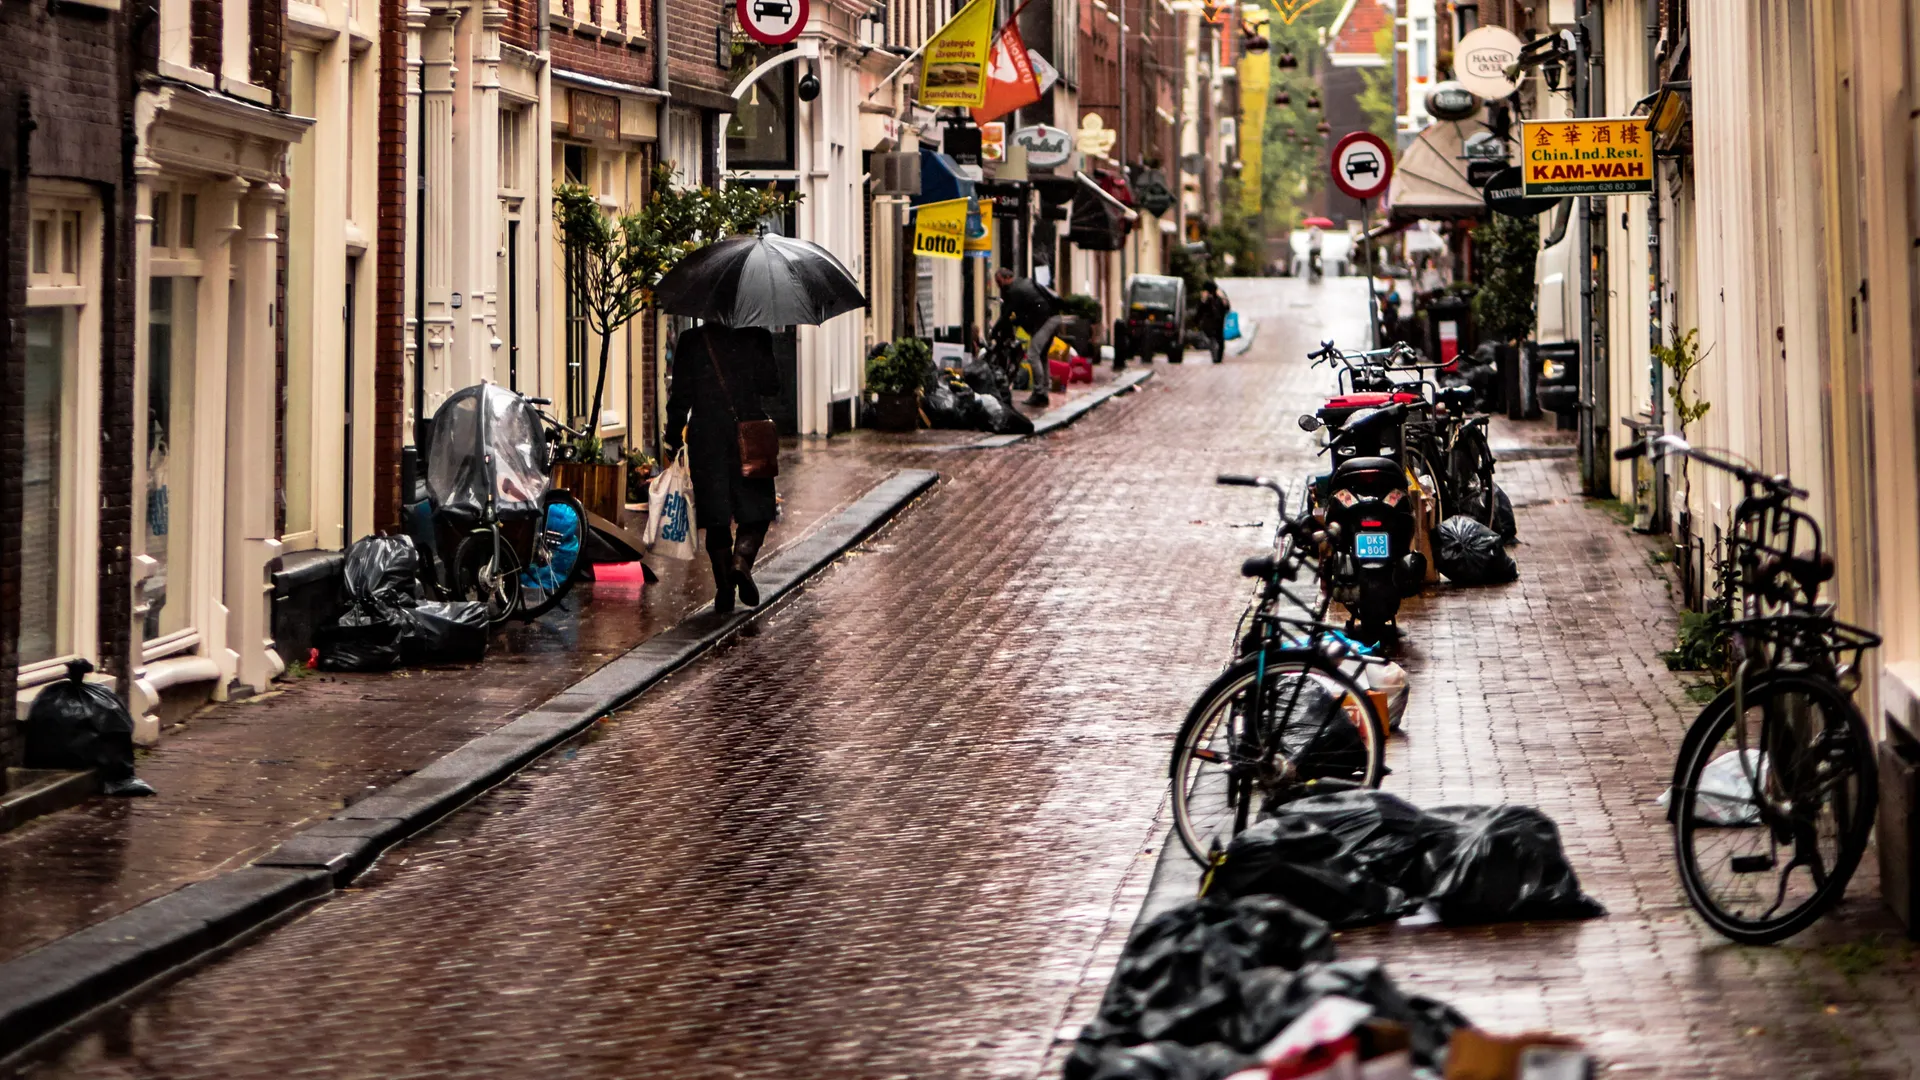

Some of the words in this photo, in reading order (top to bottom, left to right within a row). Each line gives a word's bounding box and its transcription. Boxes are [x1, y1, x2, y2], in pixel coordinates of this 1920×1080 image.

[924, 90, 977, 99] Sandwiches
[1534, 123, 1642, 147] 金華酒樓
[1531, 147, 1643, 161] Chin.Ind.Rest.
[1533, 162, 1643, 180] KAM-WAH
[1598, 182, 1613, 191] 626
[1615, 182, 1625, 191] 82
[1626, 182, 1637, 190] 30
[1366, 535, 1385, 545] DKS
